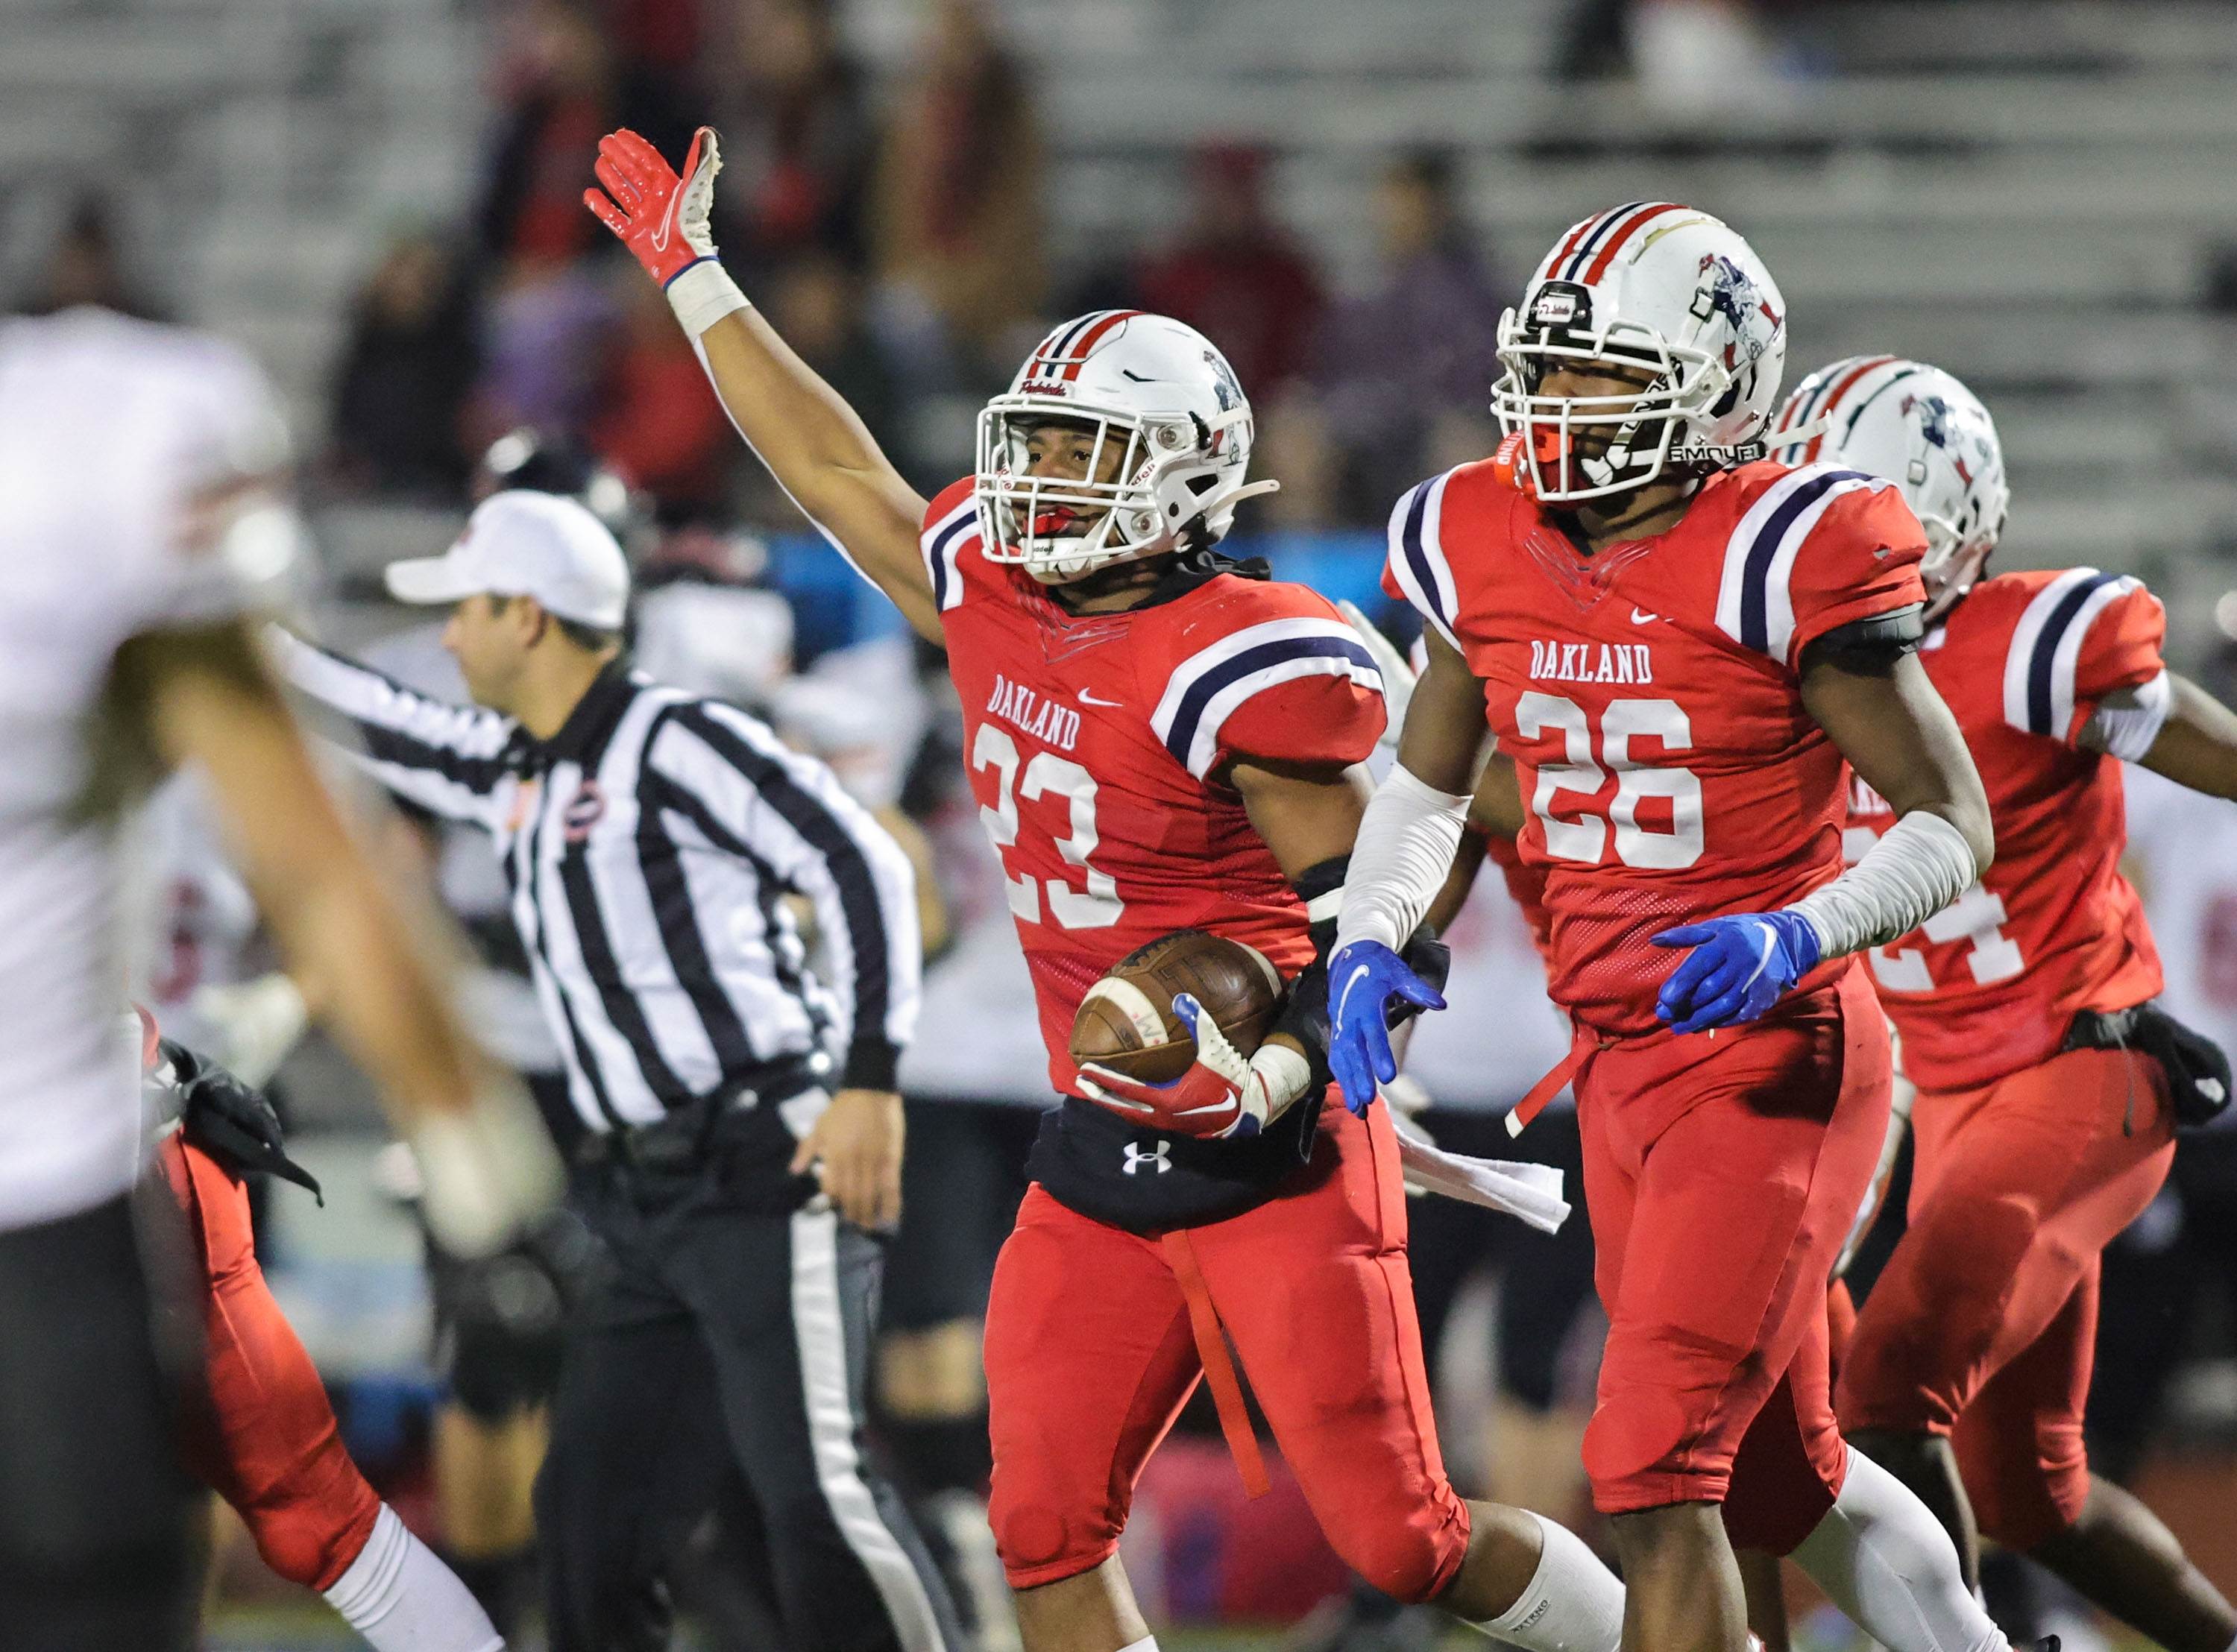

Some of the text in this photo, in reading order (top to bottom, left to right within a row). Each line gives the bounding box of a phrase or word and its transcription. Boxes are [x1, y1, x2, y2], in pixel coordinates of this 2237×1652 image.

[1670, 445, 1755, 461] RMOUR
[1530, 640, 1653, 684] OAKLAND
[987, 674, 1080, 751] OAKLAND
[1515, 690, 1705, 869] 26
[973, 722, 1125, 927] 23
